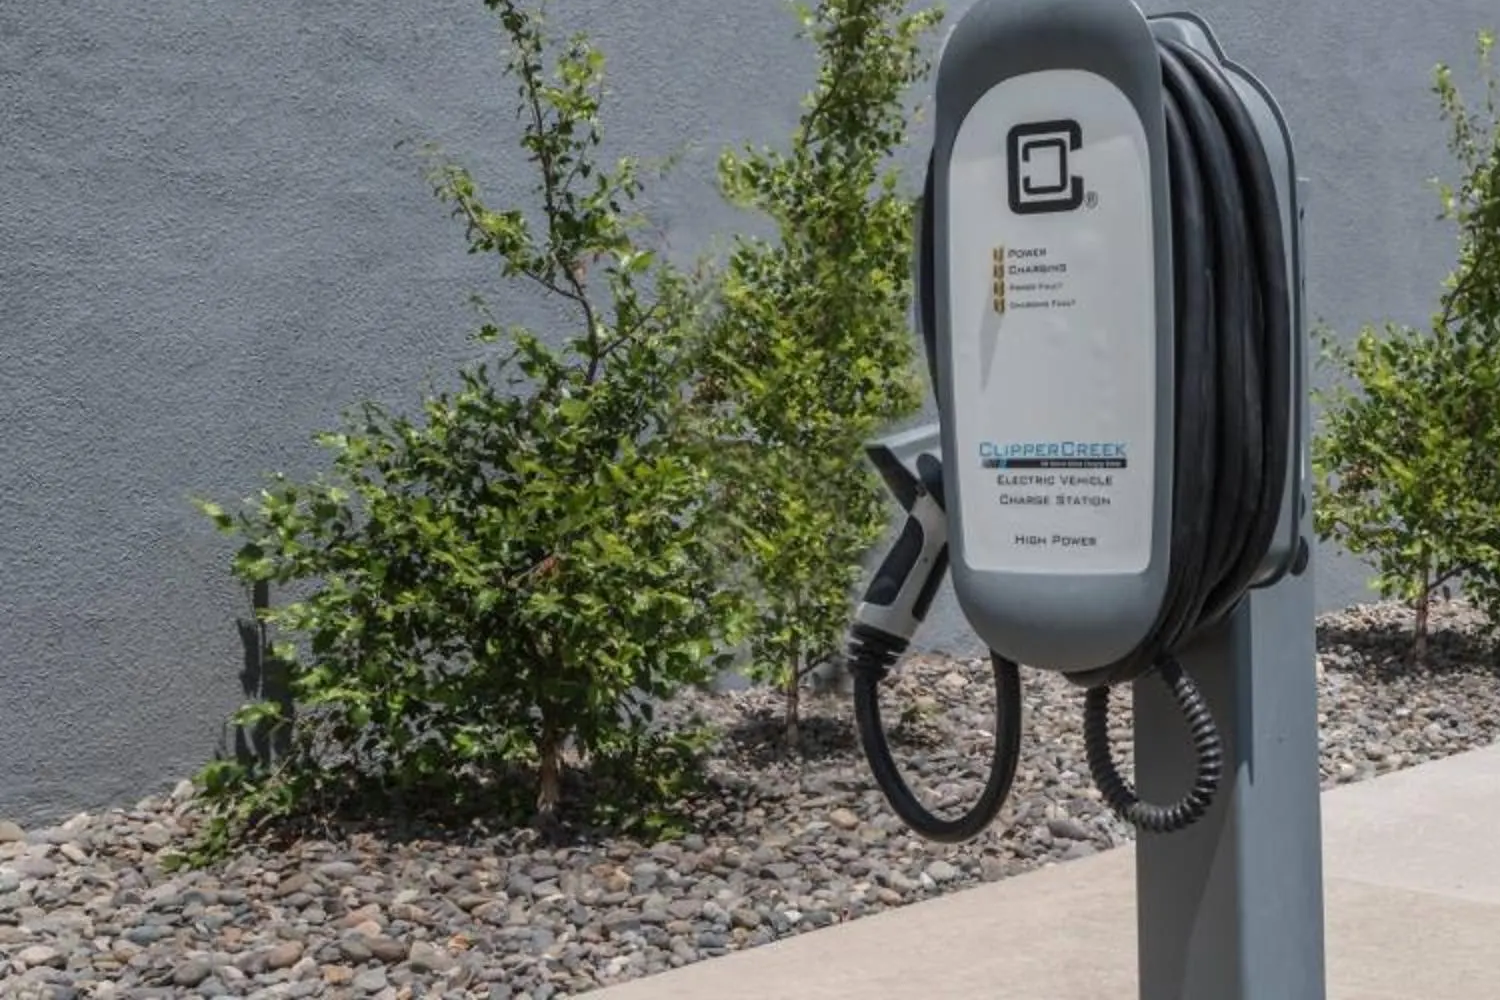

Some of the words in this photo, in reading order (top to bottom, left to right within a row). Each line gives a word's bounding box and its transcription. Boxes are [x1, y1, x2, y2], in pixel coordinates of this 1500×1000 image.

[996, 474, 1055, 486] ELECTRIC
[1059, 474, 1113, 486] VEHICLE
[999, 493, 1050, 505] CHARGE
[1015, 535, 1048, 545] HIGH
[1051, 535, 1097, 546] POWER
